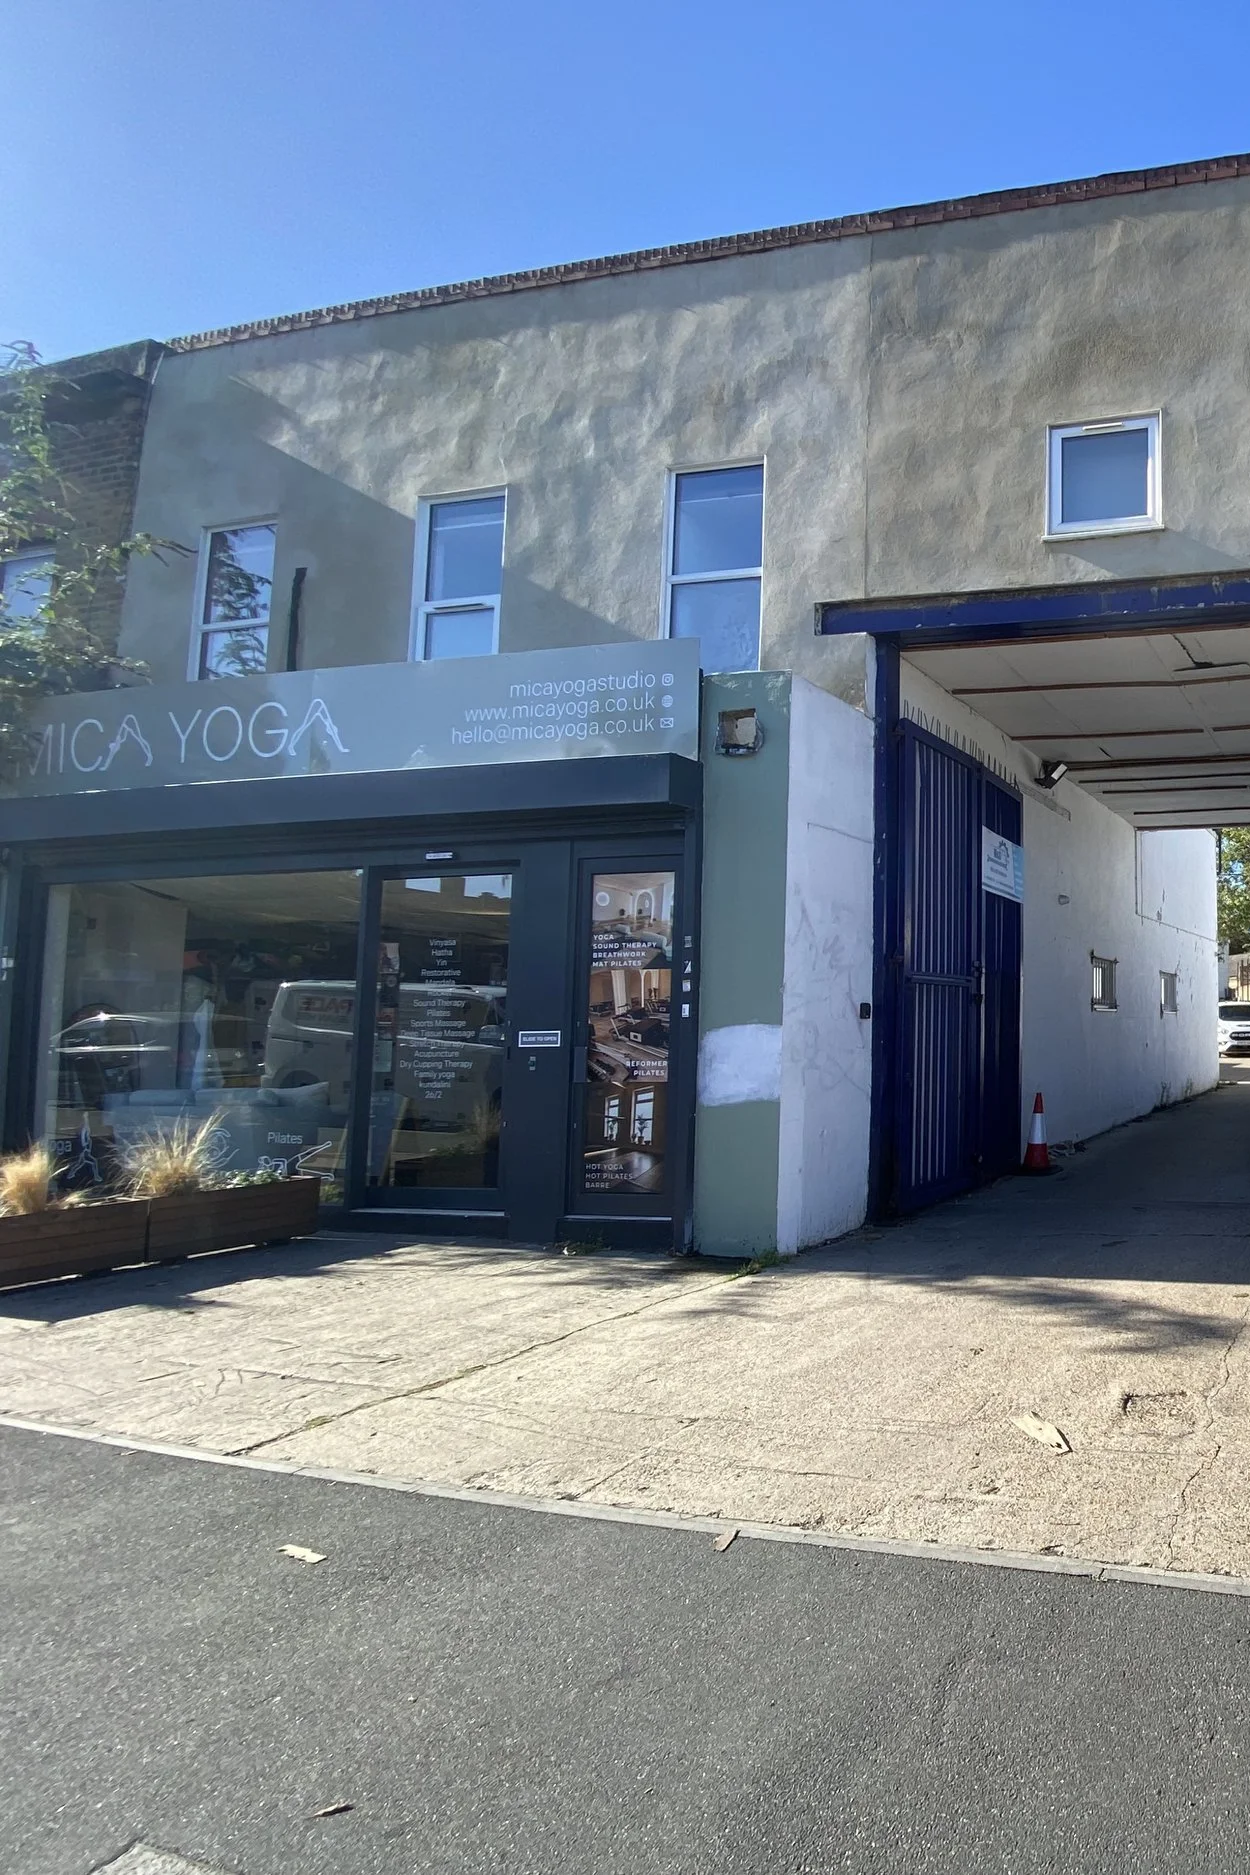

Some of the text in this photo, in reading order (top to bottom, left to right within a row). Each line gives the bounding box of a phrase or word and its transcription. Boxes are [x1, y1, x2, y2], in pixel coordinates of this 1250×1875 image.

[509, 671, 656, 698] micayogastudio
[464, 692, 656, 723] www.micayoga.co.uk
[168, 698, 351, 764] YOGA
[451, 714, 656, 745] hello@micayoga.co.uk
[429, 939, 457, 948] Vinyasa
[431, 949, 453, 957] Hatha
[592, 951, 646, 959] BREATHWORK
[436, 959, 447, 967] Yin
[592, 959, 642, 968] MAT PILATES
[421, 969, 461, 977] Restorative
[413, 999, 466, 1008] Sound Therapy
[426, 1009, 451, 1017] Pilates
[410, 1020, 467, 1029] Sports Massage
[443, 1029, 476, 1039] Massage
[414, 1050, 460, 1058] Acupuncture
[400, 1060, 473, 1070] Dry Cupping Therapy
[414, 1070, 437, 1079] Family
[633, 1069, 665, 1077] PILATES
[267, 1131, 303, 1145] Pilates
[602, 1172, 633, 1180] PILATES
[585, 1181, 610, 1189] BARRE
